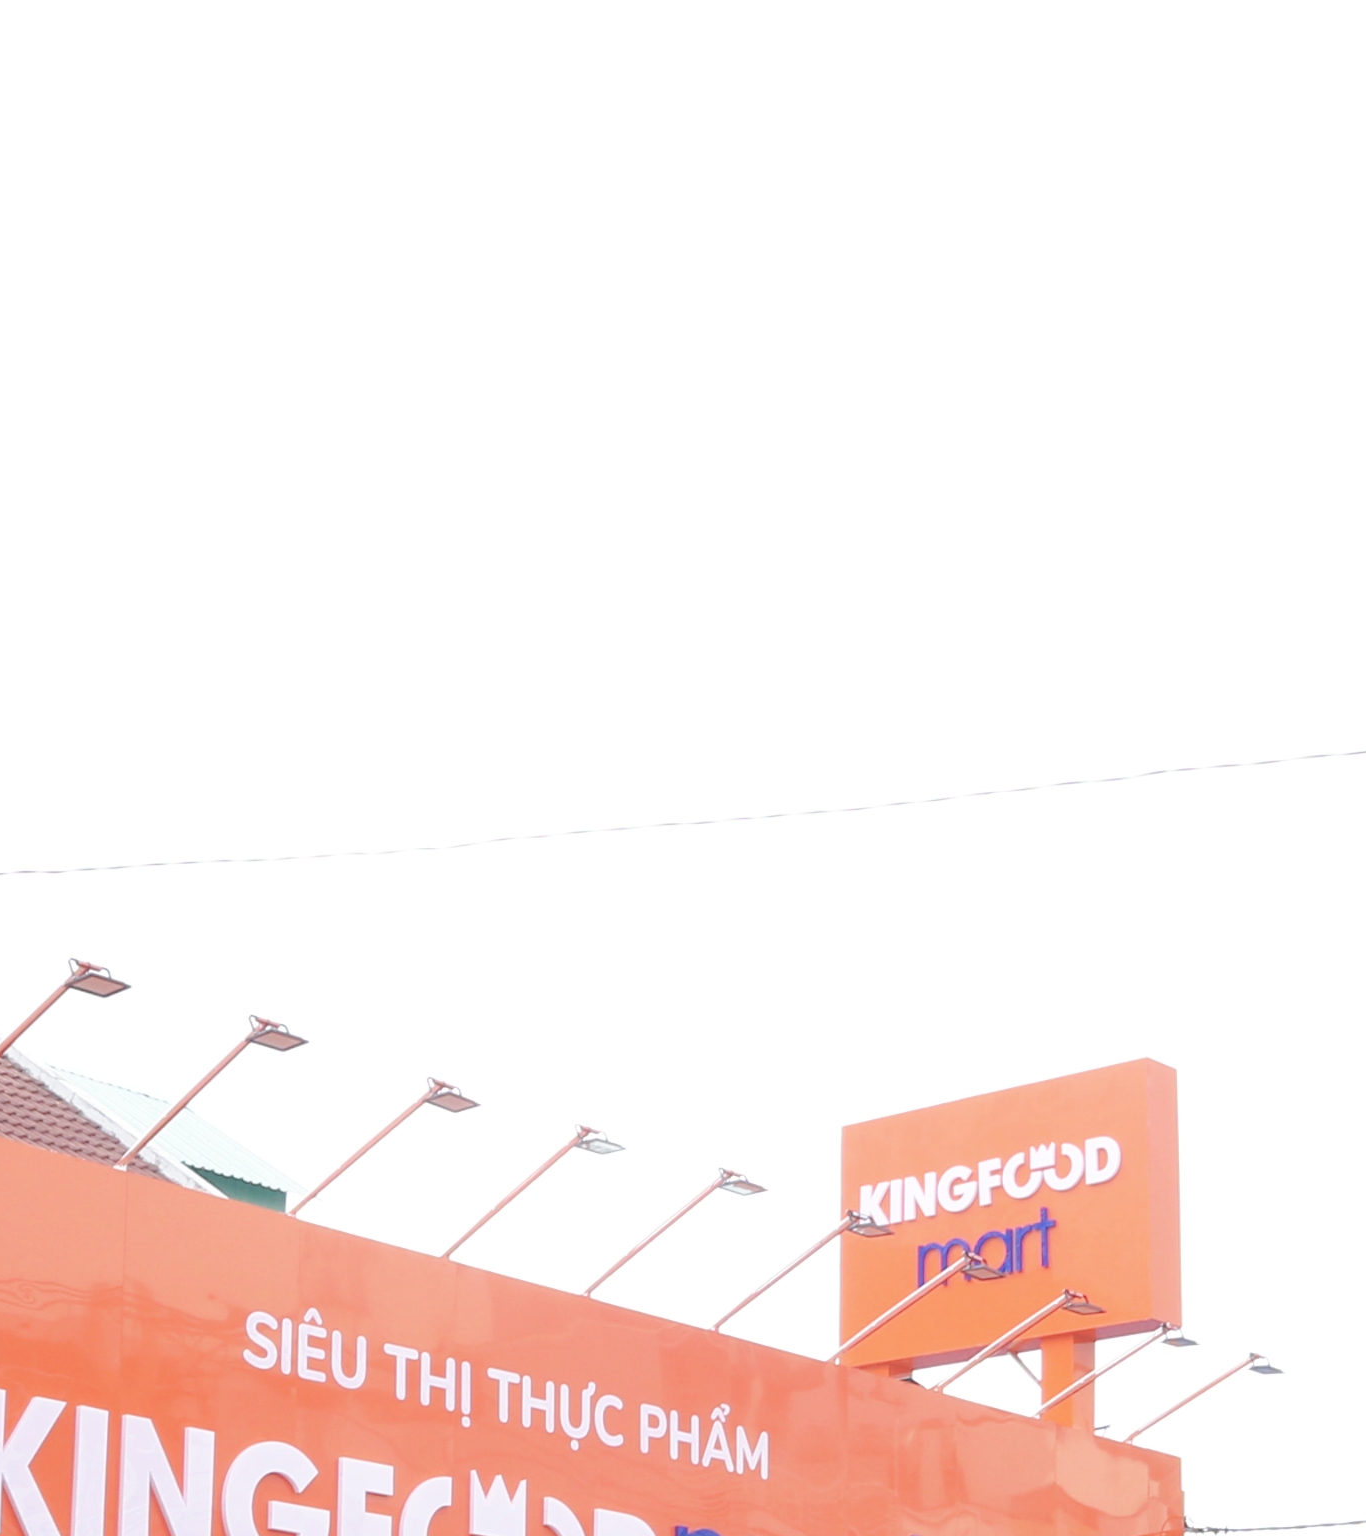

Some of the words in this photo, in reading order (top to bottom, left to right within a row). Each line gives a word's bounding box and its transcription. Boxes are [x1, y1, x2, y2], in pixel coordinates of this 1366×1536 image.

[859, 1136, 1121, 1227] KINGFOOD
[918, 1207, 1056, 1288] mart
[243, 1308, 367, 1389] SIÊU
[383, 1343, 472, 1428] THỊ
[487, 1367, 624, 1451] THỰC
[640, 1404, 769, 1480] PHẨM
